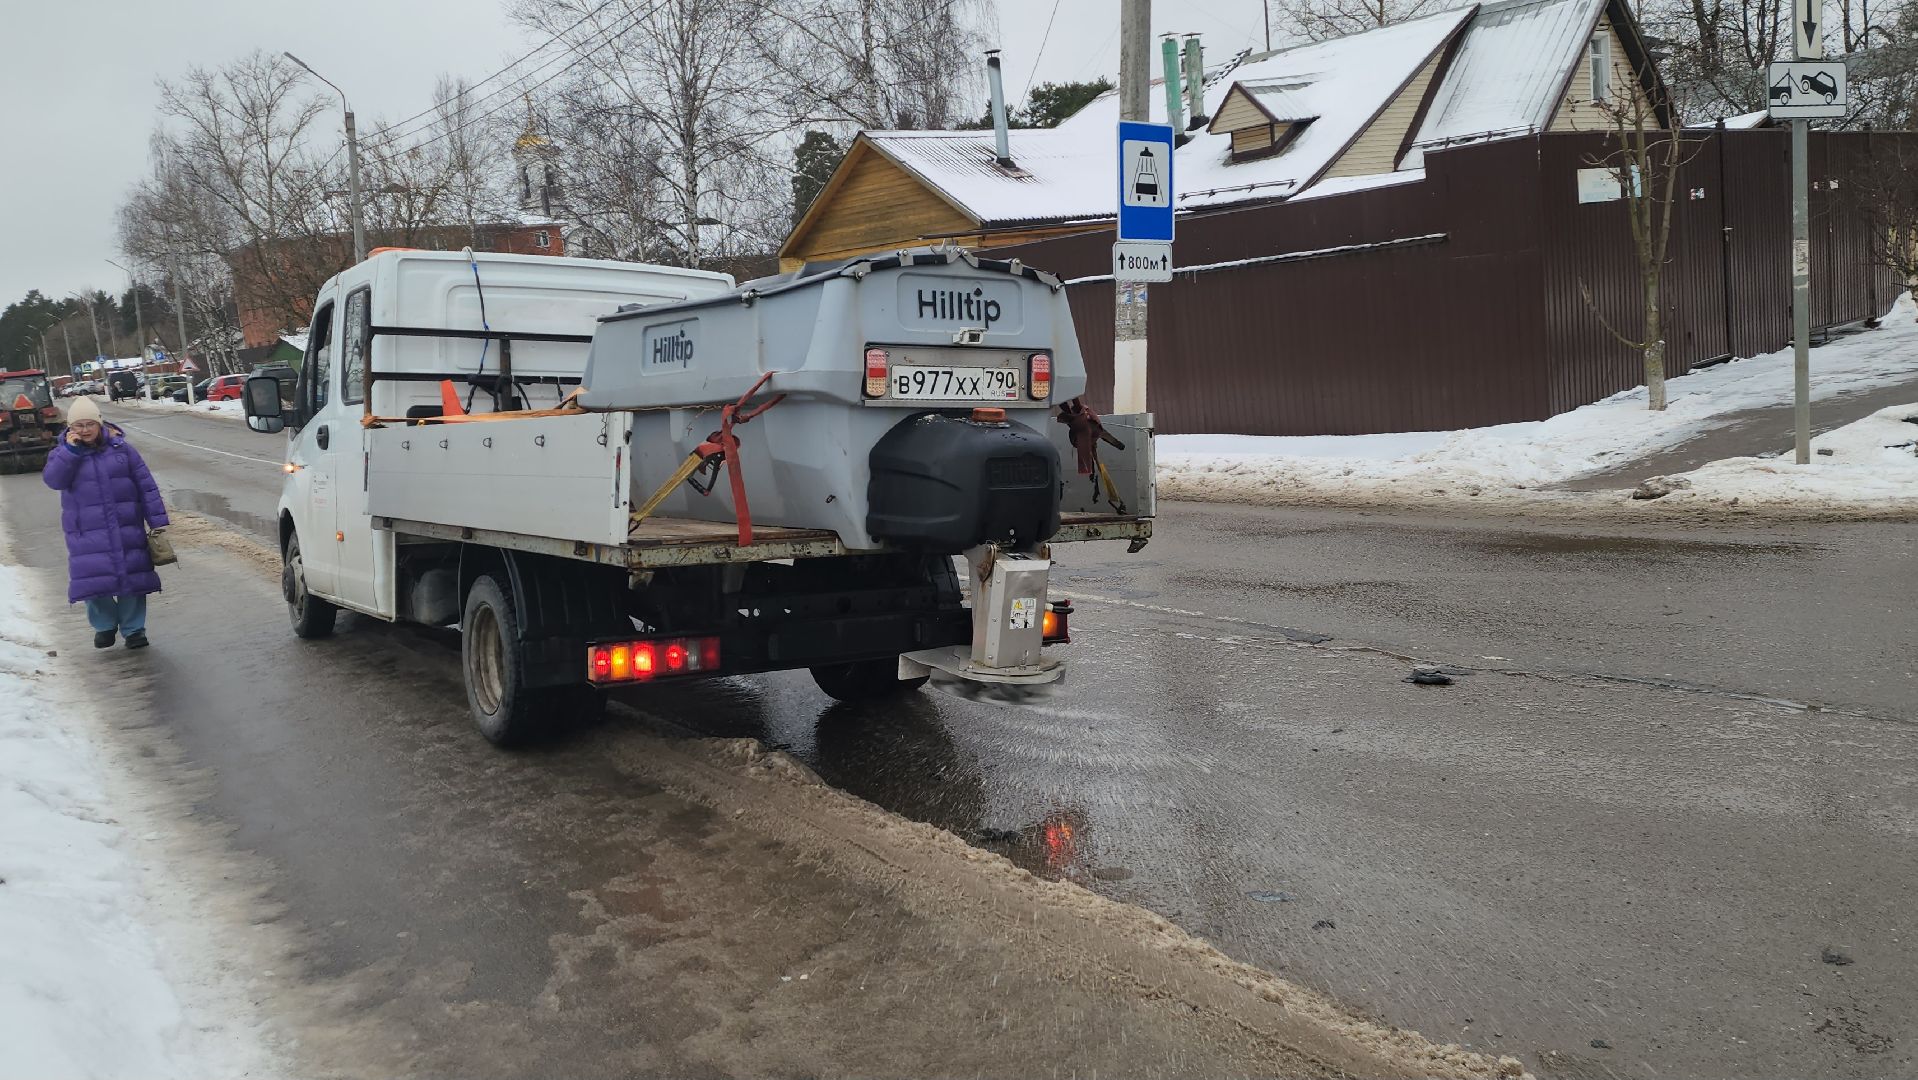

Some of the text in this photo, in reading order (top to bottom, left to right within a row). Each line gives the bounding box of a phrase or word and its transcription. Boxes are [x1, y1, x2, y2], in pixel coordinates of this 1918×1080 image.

[1128, 255, 1159, 270] 800м
[918, 288, 1001, 330] Hilltip
[653, 330, 694, 368] Hilltip
[985, 370, 1015, 389] 790
